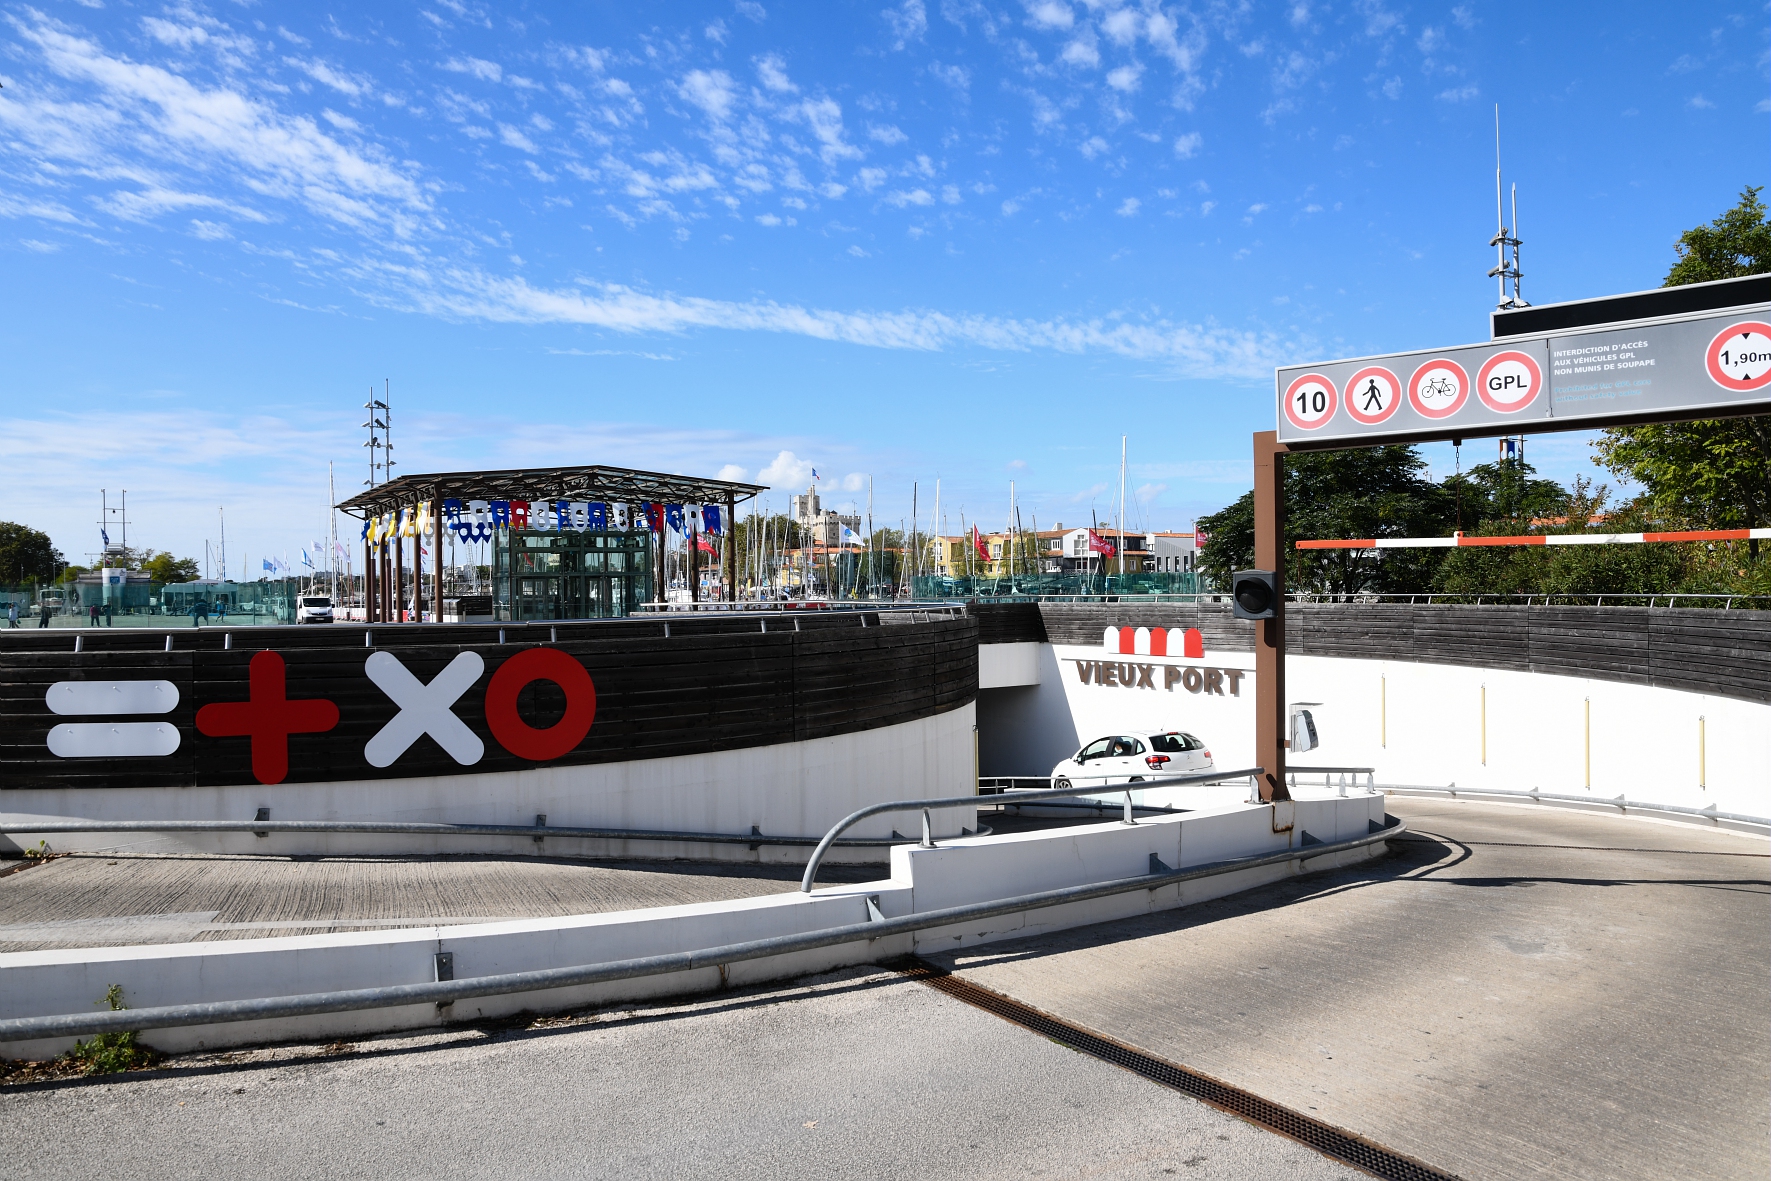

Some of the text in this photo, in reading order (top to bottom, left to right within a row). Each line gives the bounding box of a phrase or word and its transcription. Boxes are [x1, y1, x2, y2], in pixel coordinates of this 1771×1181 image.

[1553, 340, 1649, 358] INTERDICTION D'ACCÈS
[1553, 351, 1636, 367] AUX VÉHICULES GPL
[1554, 358, 1656, 376] NON MUNIS DE SOUPAPE
[1488, 373, 1530, 391] GPL
[1554, 379, 1652, 394] Prohibited for GPL cars
[1295, 391, 1327, 415] 10
[1555, 393, 1588, 403] without
[1590, 391, 1616, 400] safety
[1075, 660, 1244, 696] VIEUX PORT
